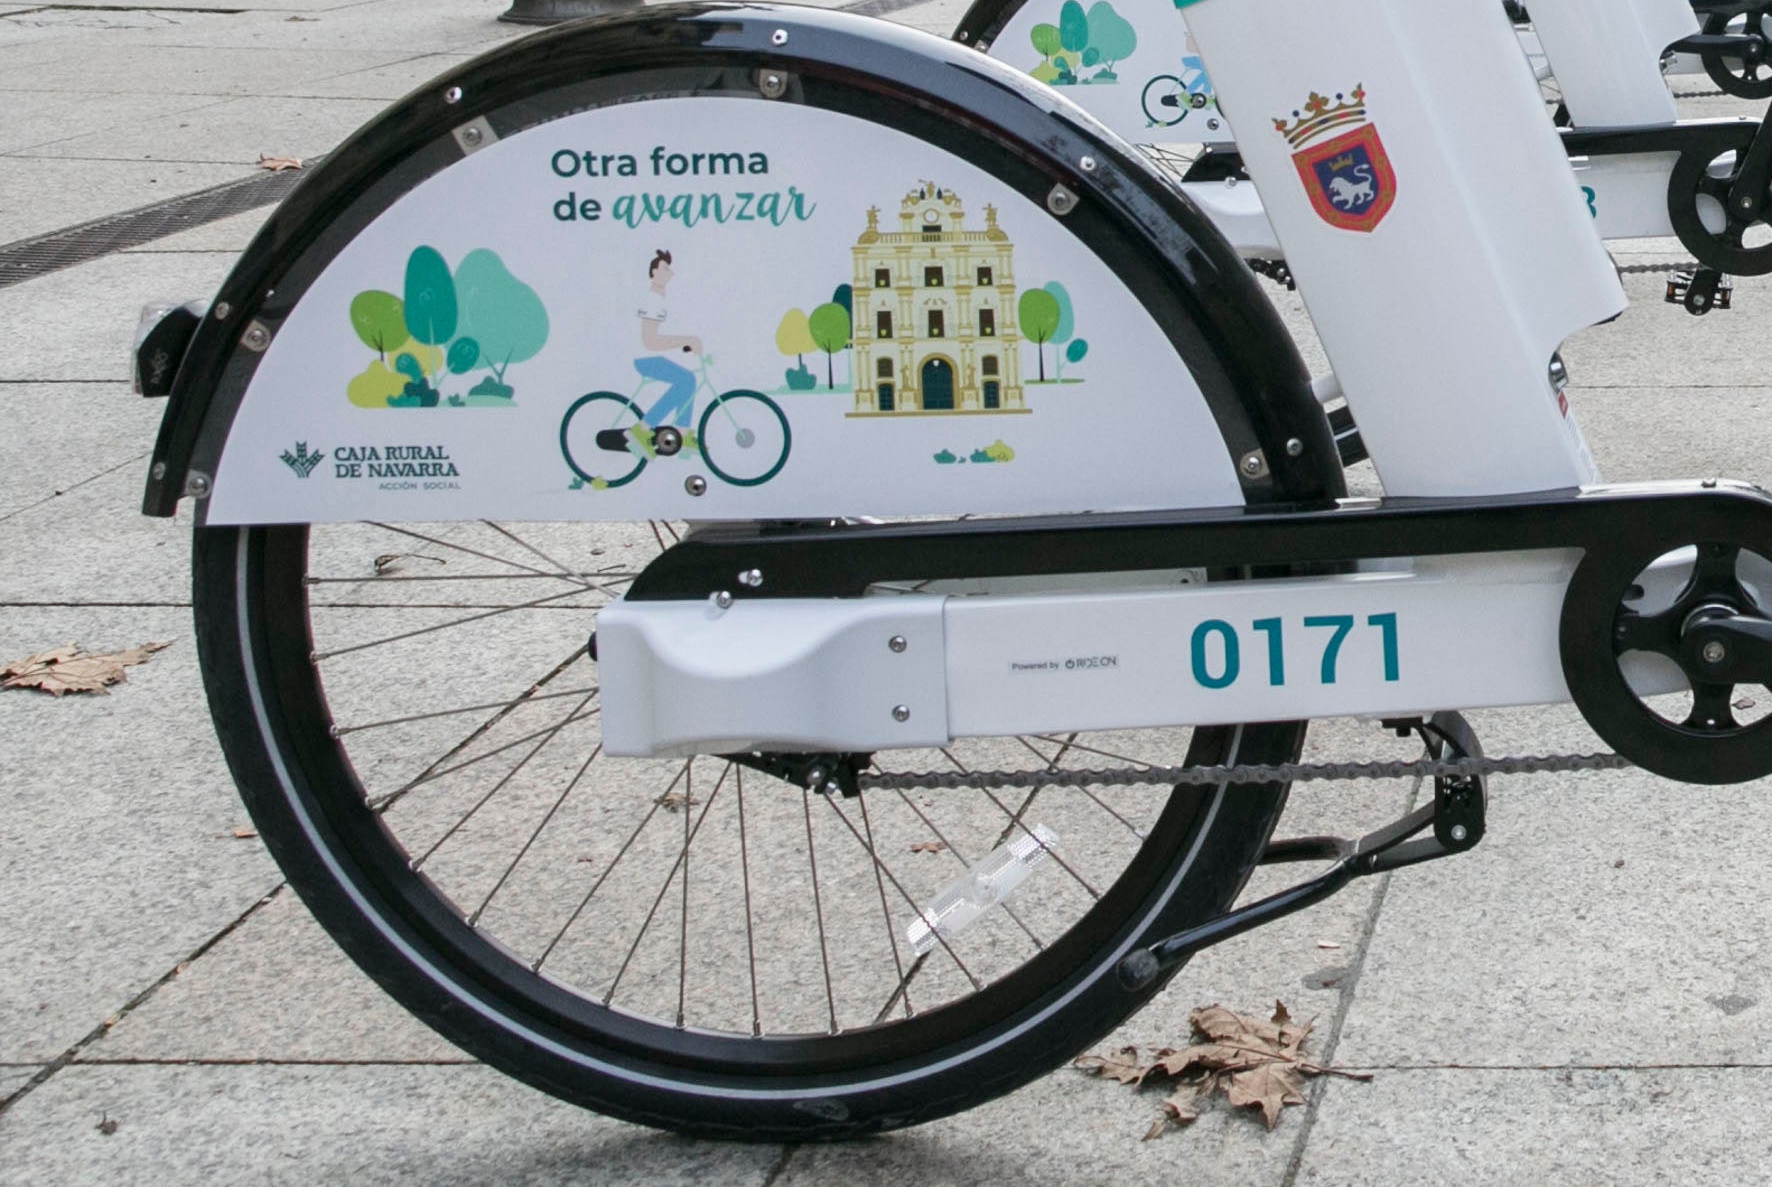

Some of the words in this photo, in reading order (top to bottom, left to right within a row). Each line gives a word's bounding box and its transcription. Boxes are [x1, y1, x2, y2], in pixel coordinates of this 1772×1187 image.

[551, 148, 638, 178] Otra
[650, 146, 769, 176] forma
[553, 191, 602, 222] de
[612, 185, 817, 229] avanzar
[333, 446, 381, 462] CAJA
[384, 445, 450, 461] RURAL
[335, 463, 362, 478] DE
[367, 462, 460, 478] NAVARRA
[378, 480, 418, 491] ACCIÓN
[422, 481, 461, 491] SOCIAL
[1190, 612, 1400, 689] 0171
[1012, 661, 1048, 670] Powered
[1049, 661, 1060, 671] by
